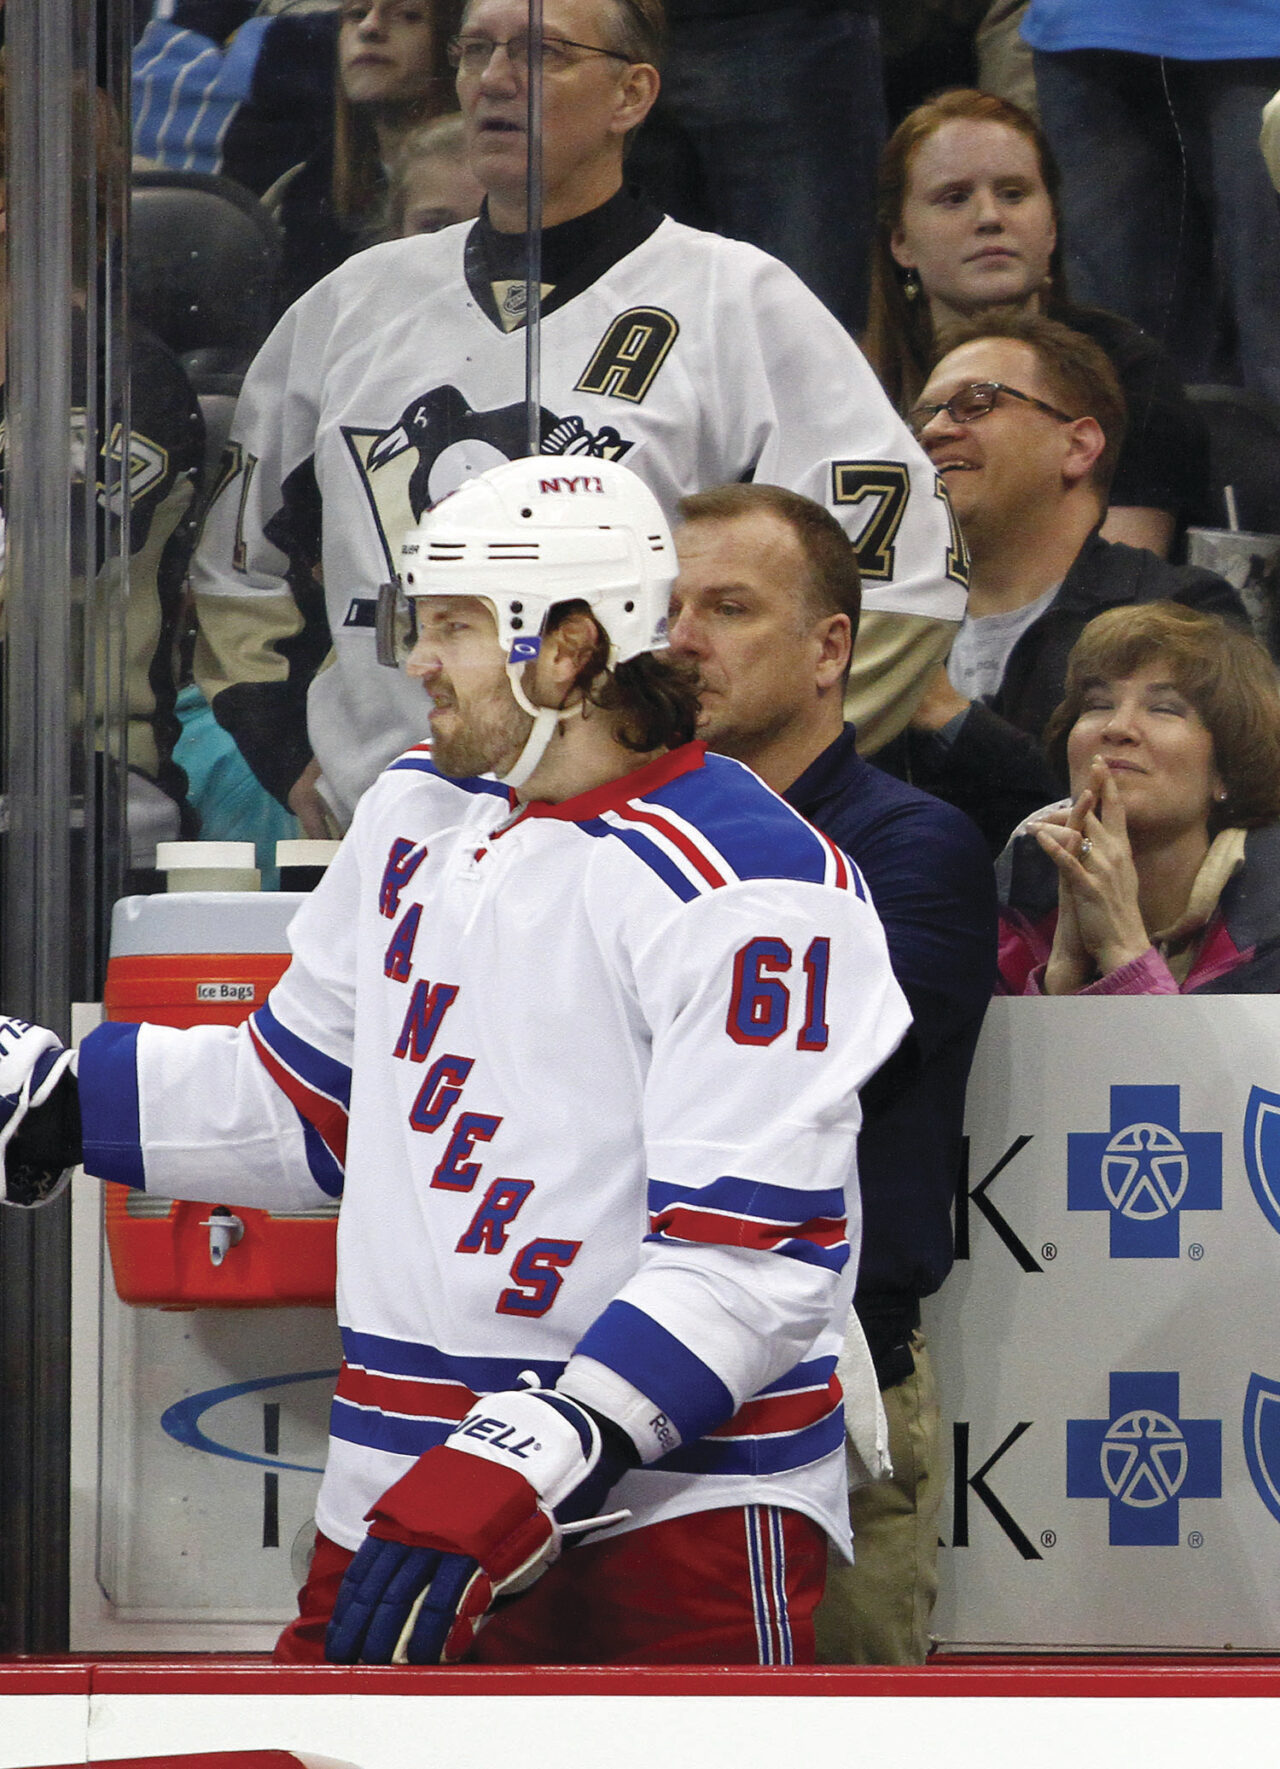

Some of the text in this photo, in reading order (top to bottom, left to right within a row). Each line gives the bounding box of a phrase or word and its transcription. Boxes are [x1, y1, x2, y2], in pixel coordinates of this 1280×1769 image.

[573, 305, 680, 404] A
[832, 460, 972, 592] 71
[198, 984, 253, 1000] Ice Bags
[726, 936, 831, 1052] 61
[379, 837, 583, 1319] RANGERS
